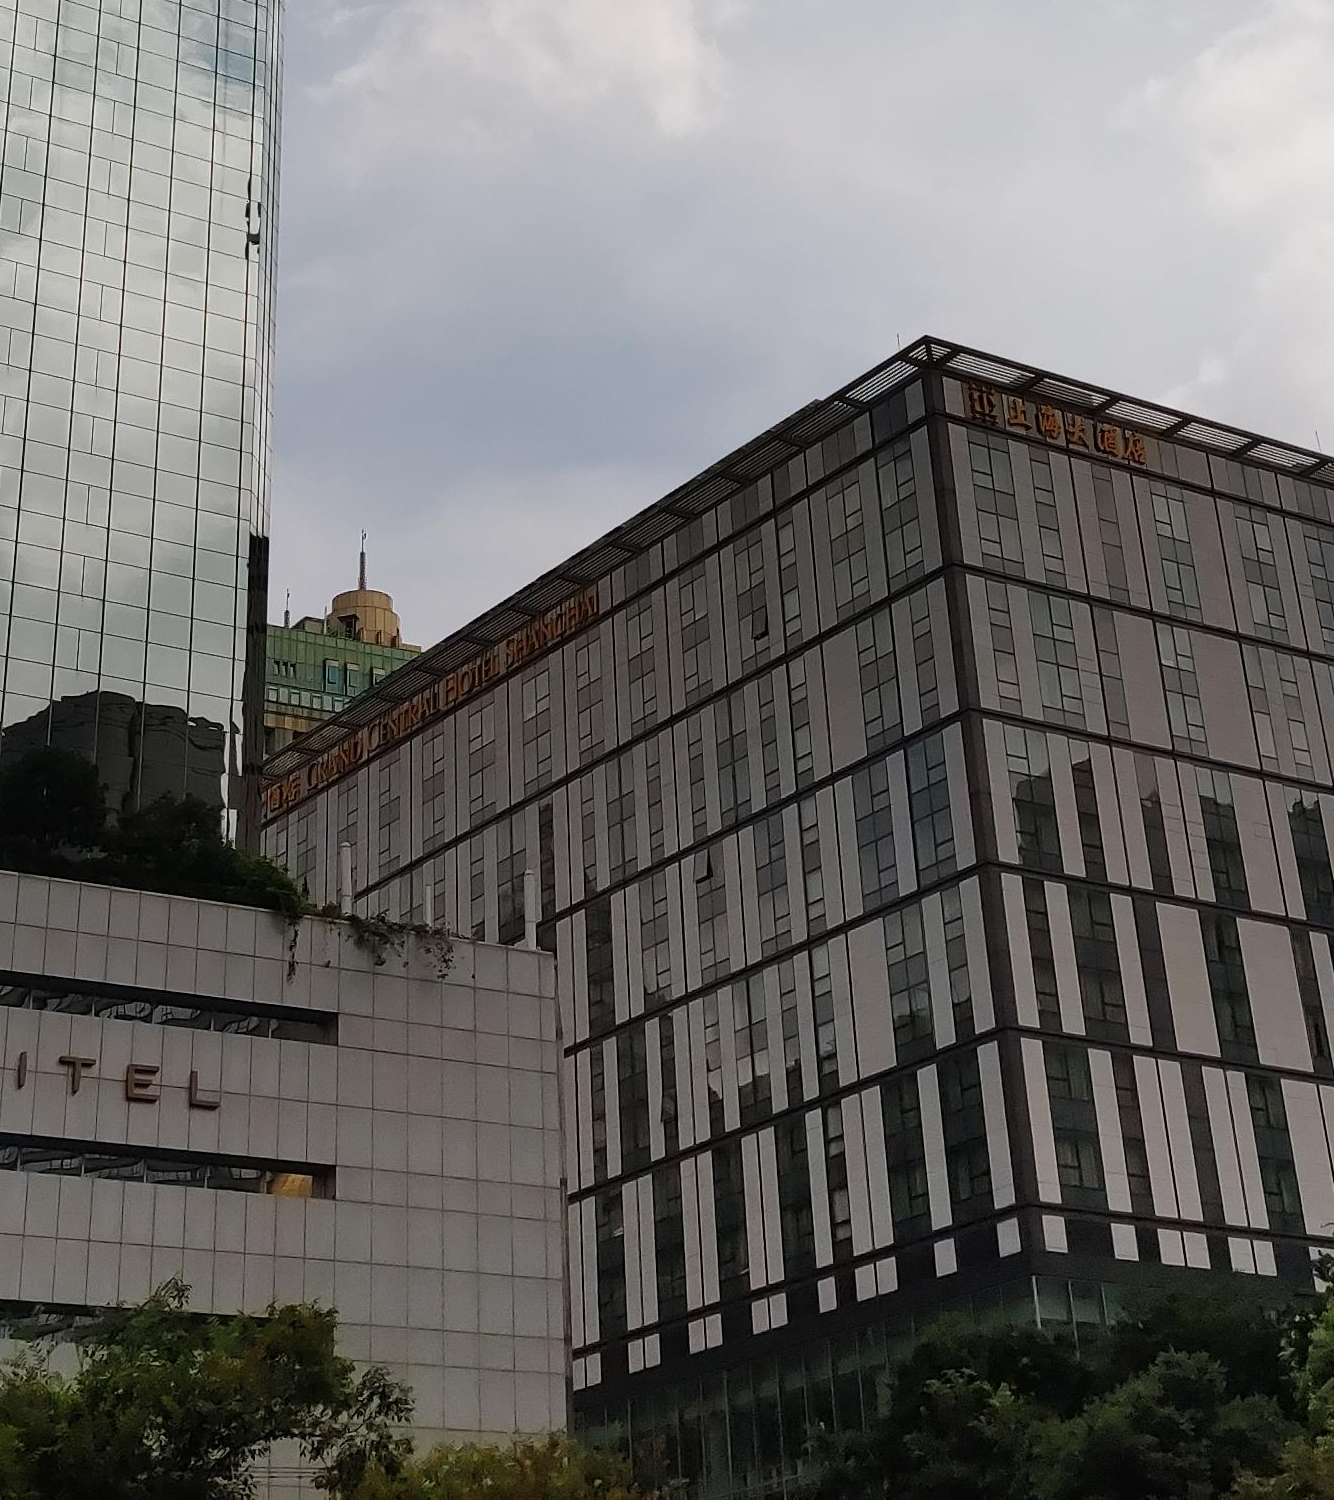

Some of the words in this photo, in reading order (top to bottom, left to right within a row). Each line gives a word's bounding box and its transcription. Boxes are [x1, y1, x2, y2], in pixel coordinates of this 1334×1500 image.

[308, 739, 362, 792] GRAND
[368, 691, 439, 752] CENTRAL
[444, 655, 499, 704] HOTEL
[506, 594, 597, 668] SHANGHAI
